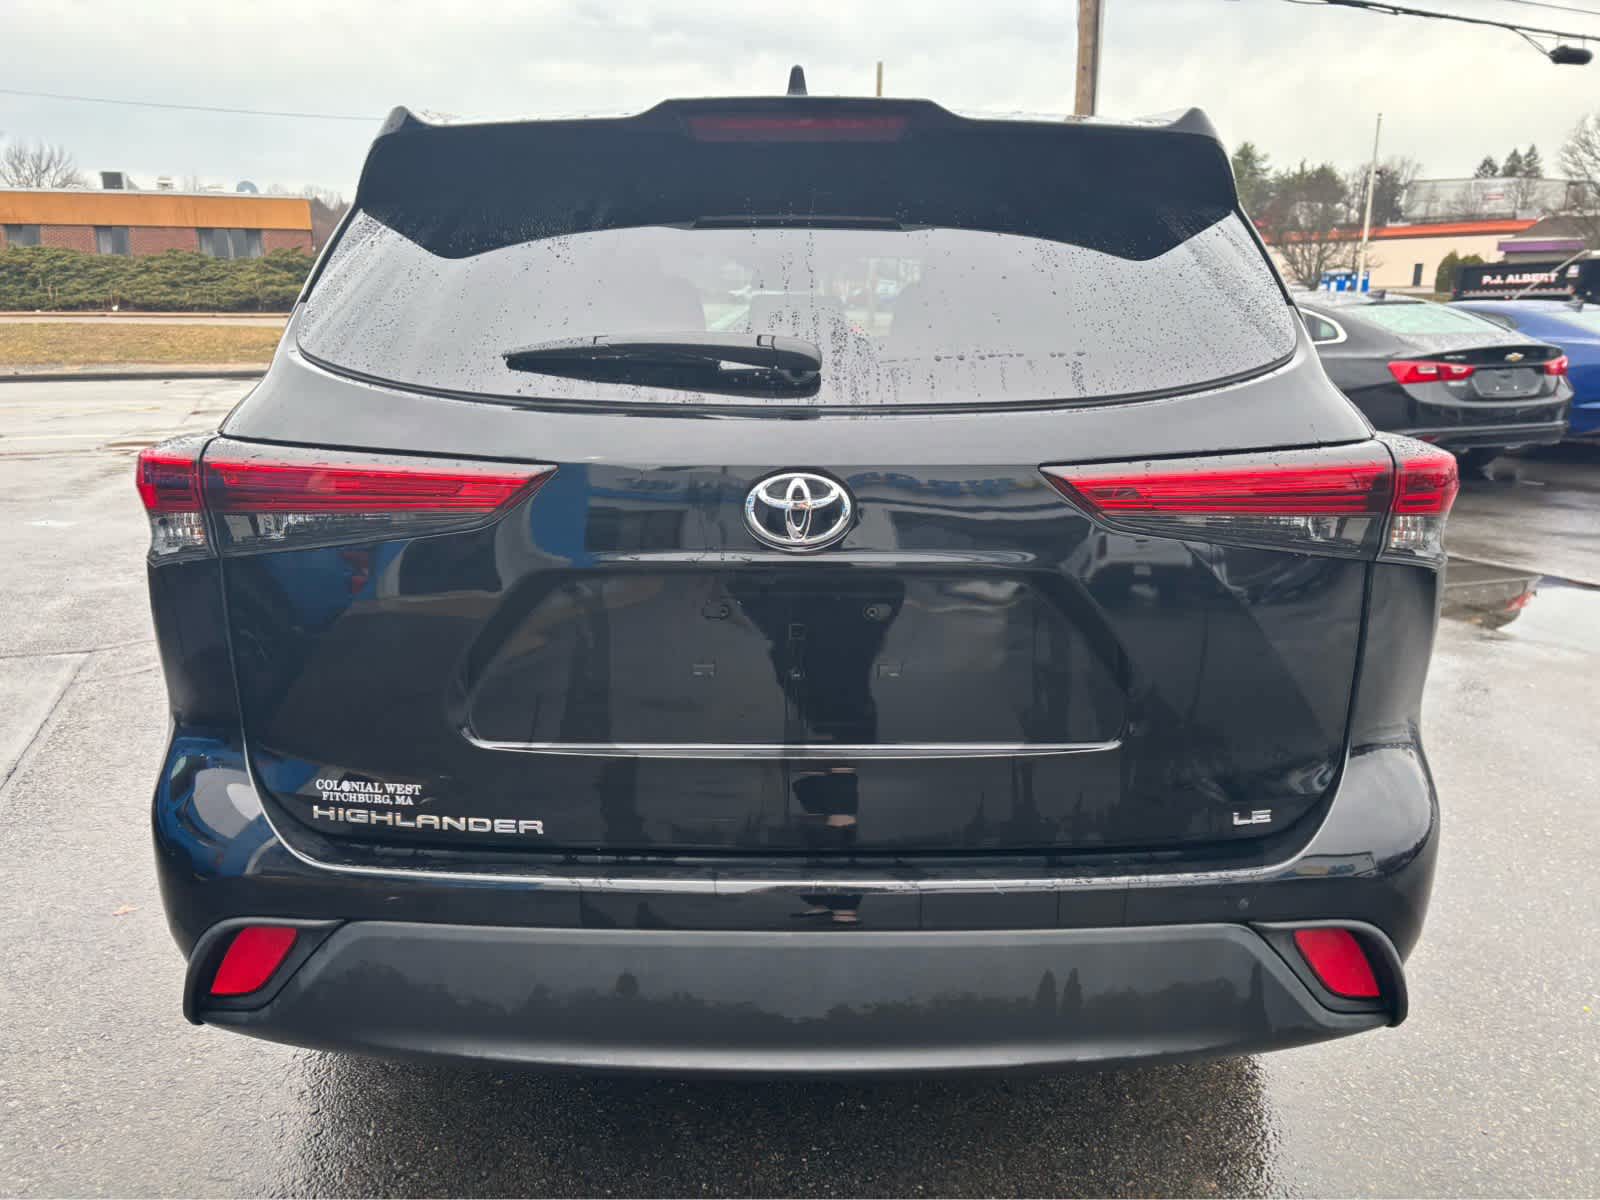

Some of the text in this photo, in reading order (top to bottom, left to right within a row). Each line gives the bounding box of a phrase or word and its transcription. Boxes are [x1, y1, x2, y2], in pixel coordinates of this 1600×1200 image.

[1505, 272, 1559, 284] ALBERT
[315, 778, 422, 796] COLONIAL WEST
[322, 791, 414, 806] FITCHBURG, MA
[312, 805, 544, 835] HIGHLANDER
[1232, 809, 1272, 826] LE
